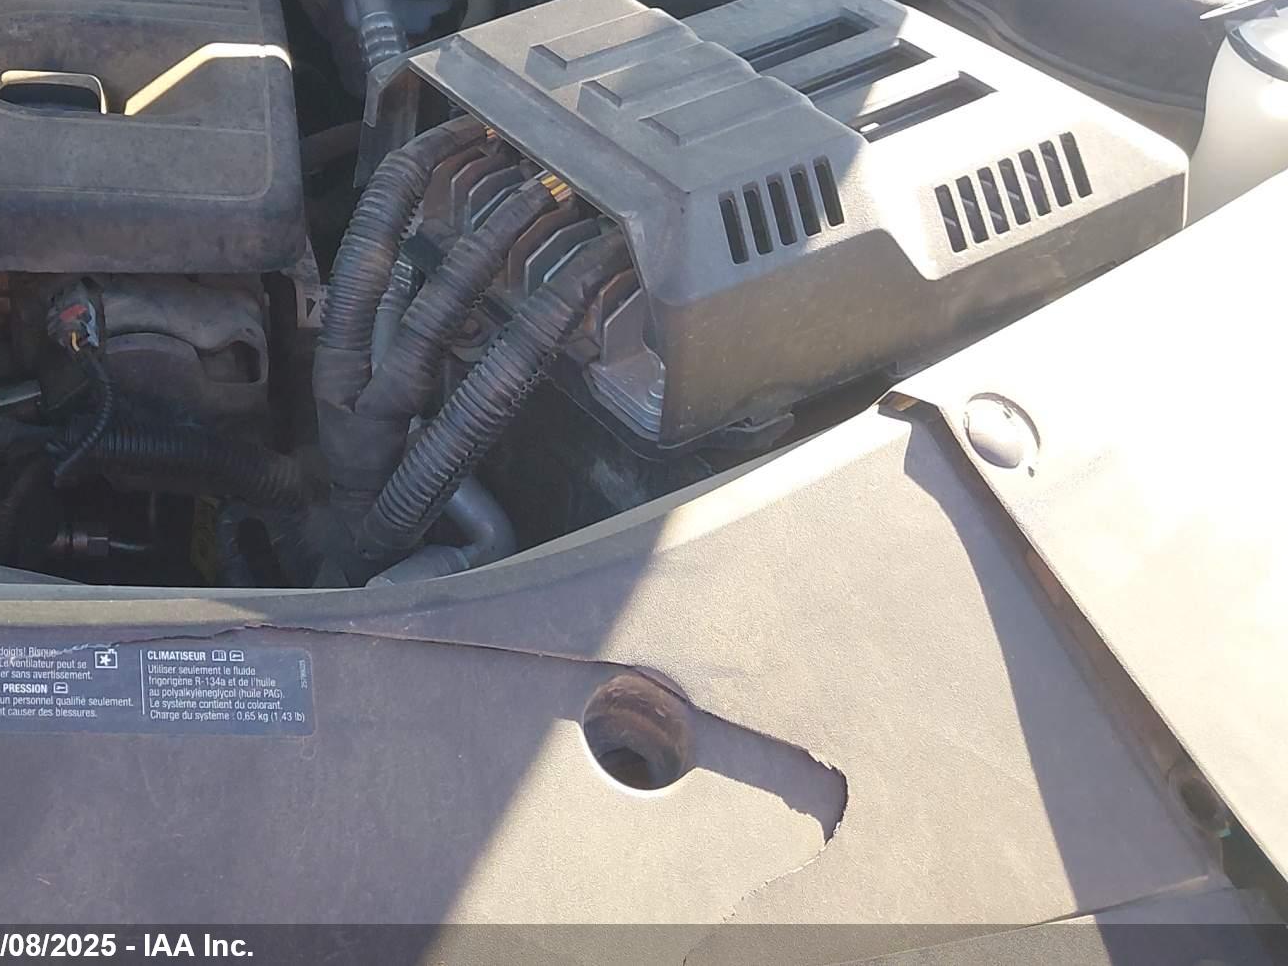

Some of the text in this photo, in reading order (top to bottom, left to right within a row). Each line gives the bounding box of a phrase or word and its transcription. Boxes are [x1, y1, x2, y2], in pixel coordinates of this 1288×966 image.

[147, 650, 206, 661] CLIMATISEUR
[0, 658, 9, 668] Le
[11, 658, 54, 669] ventilateur
[56, 660, 75, 672] peut
[147, 665, 256, 675] Utiliser seulement le fluide
[11, 671, 31, 679] sans
[32, 670, 93, 680] avertissement.
[148, 676, 277, 688] frigorigène R-134a et de l'huile
[3, 683, 48, 694] PRESSION
[149, 689, 160, 697] au
[238, 688, 262, 699] (huile
[263, 688, 286, 700] PAG).
[0, 697, 11, 705] un
[12, 696, 53, 707] personnel
[88, 697, 134, 707] seulement.
[149, 698, 283, 710] Le système contient du colorant.
[7, 708, 37, 716] causer
[38, 707, 54, 716] des
[55, 707, 97, 717] blessures.
[150, 710, 180, 722] Charge
[181, 711, 193, 720] du
[194, 711, 230, 723] système
[236, 711, 256, 722] 0,65
[258, 711, 268, 723] kg
[294, 712, 305, 722] lb)
